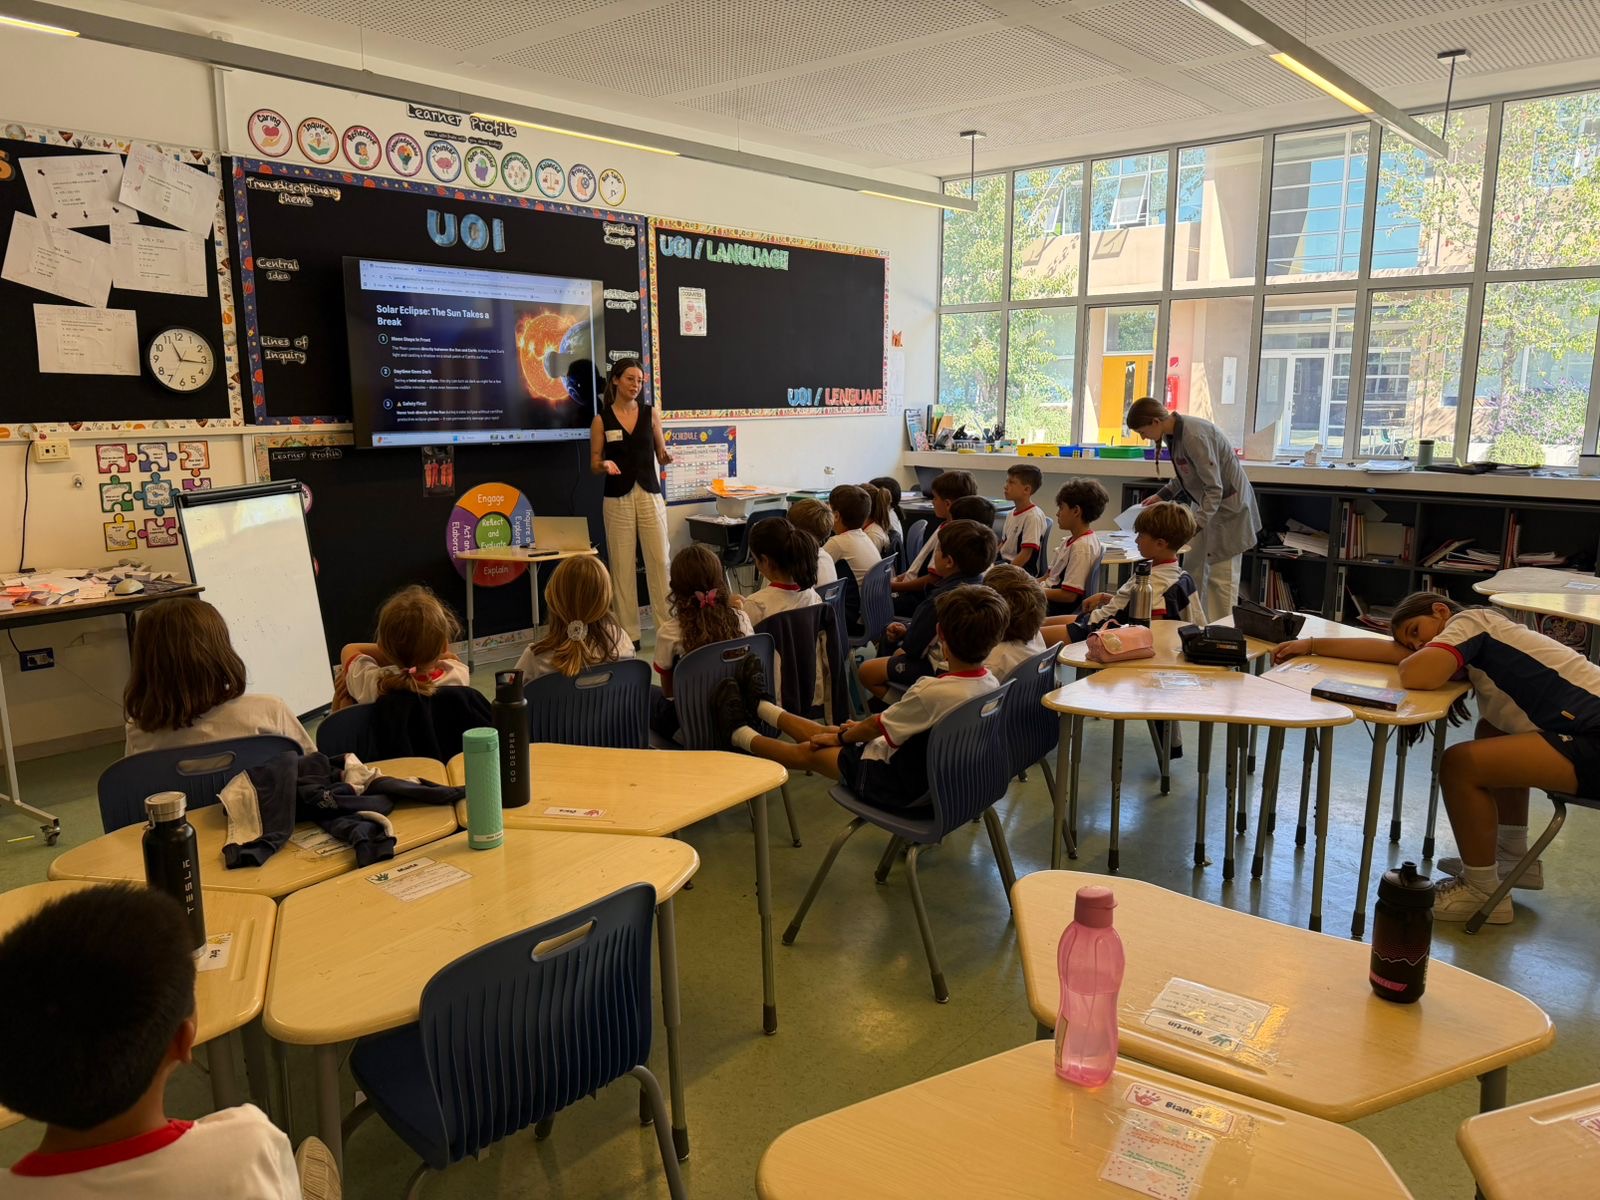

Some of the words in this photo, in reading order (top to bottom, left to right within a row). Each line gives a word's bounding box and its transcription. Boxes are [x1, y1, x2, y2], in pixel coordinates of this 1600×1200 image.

[257, 113, 282, 128] Caring
[407, 104, 462, 127] Learner
[469, 115, 518, 137] Profile
[303, 121, 333, 137] Inquirer
[347, 129, 377, 146] Reflective
[432, 143, 457, 155] Thinker
[279, 193, 313, 207] theme
[427, 208, 505, 253] UOI
[694, 238, 704, 260] /
[706, 239, 790, 271] LANGUAGE
[257, 258, 299, 270] Central
[267, 271, 289, 280] Idea
[376, 304, 399, 315] Solar
[399, 306, 431, 317] Eclipse:
[431, 307, 446, 317] The
[446, 308, 462, 318] Sun
[462, 309, 484, 319] Takes
[377, 317, 403, 327] Break
[163, 335, 172, 345] 11
[173, 332, 184, 342] 12
[261, 337, 289, 347] Lines
[295, 336, 308, 349] of
[154, 343, 164, 353] 10
[196, 344, 204, 353] 2
[152, 354, 160, 364] 9
[201, 355, 208, 365] 3
[265, 351, 307, 364] Inquiry
[157, 366, 165, 376] 8
[198, 367, 205, 376] 4
[167, 374, 174, 383] 7
[179, 377, 186, 387] 6
[190, 374, 197, 384] 5
[787, 387, 812, 407] UOI
[813, 387, 823, 407] /
[824, 387, 884, 407] LENGUAJE
[671, 432, 698, 441] SCHEDULE
[271, 451, 306, 461] Learner
[311, 448, 342, 460] Profile
[477, 494, 505, 506] Engage
[482, 518, 504, 527] Reflect
[463, 525, 472, 539] Act
[487, 530, 500, 538] and
[483, 566, 509, 577] Explain
[508, 732, 517, 767] DEEPER
[510, 770, 517, 783] GO
